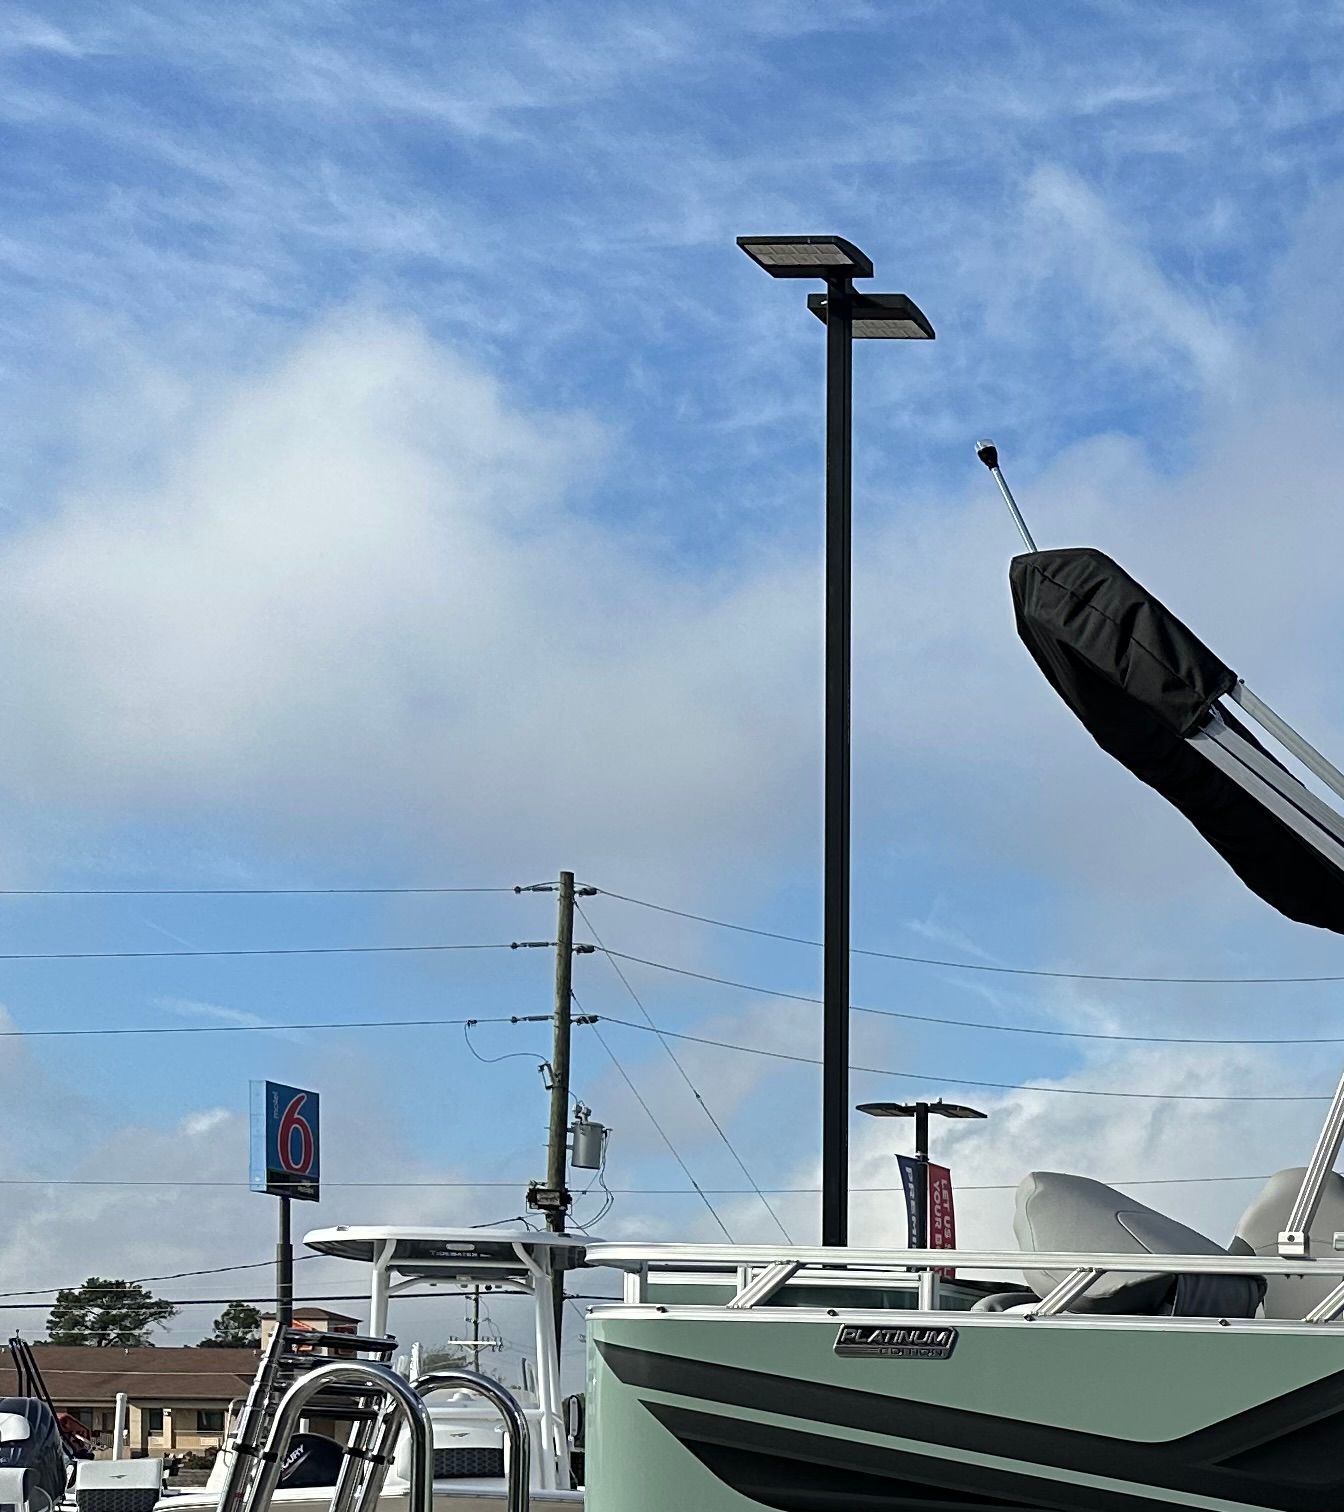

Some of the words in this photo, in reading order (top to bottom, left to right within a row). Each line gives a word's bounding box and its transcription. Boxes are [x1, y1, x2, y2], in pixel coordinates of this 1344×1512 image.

[278, 1093, 314, 1174] 6
[933, 1180, 942, 1229] YOUR
[941, 1180, 951, 1212] LET
[905, 1166, 918, 1272] PREMI
[943, 1215, 952, 1239] US
[841, 1329, 950, 1344] PLATINUM
